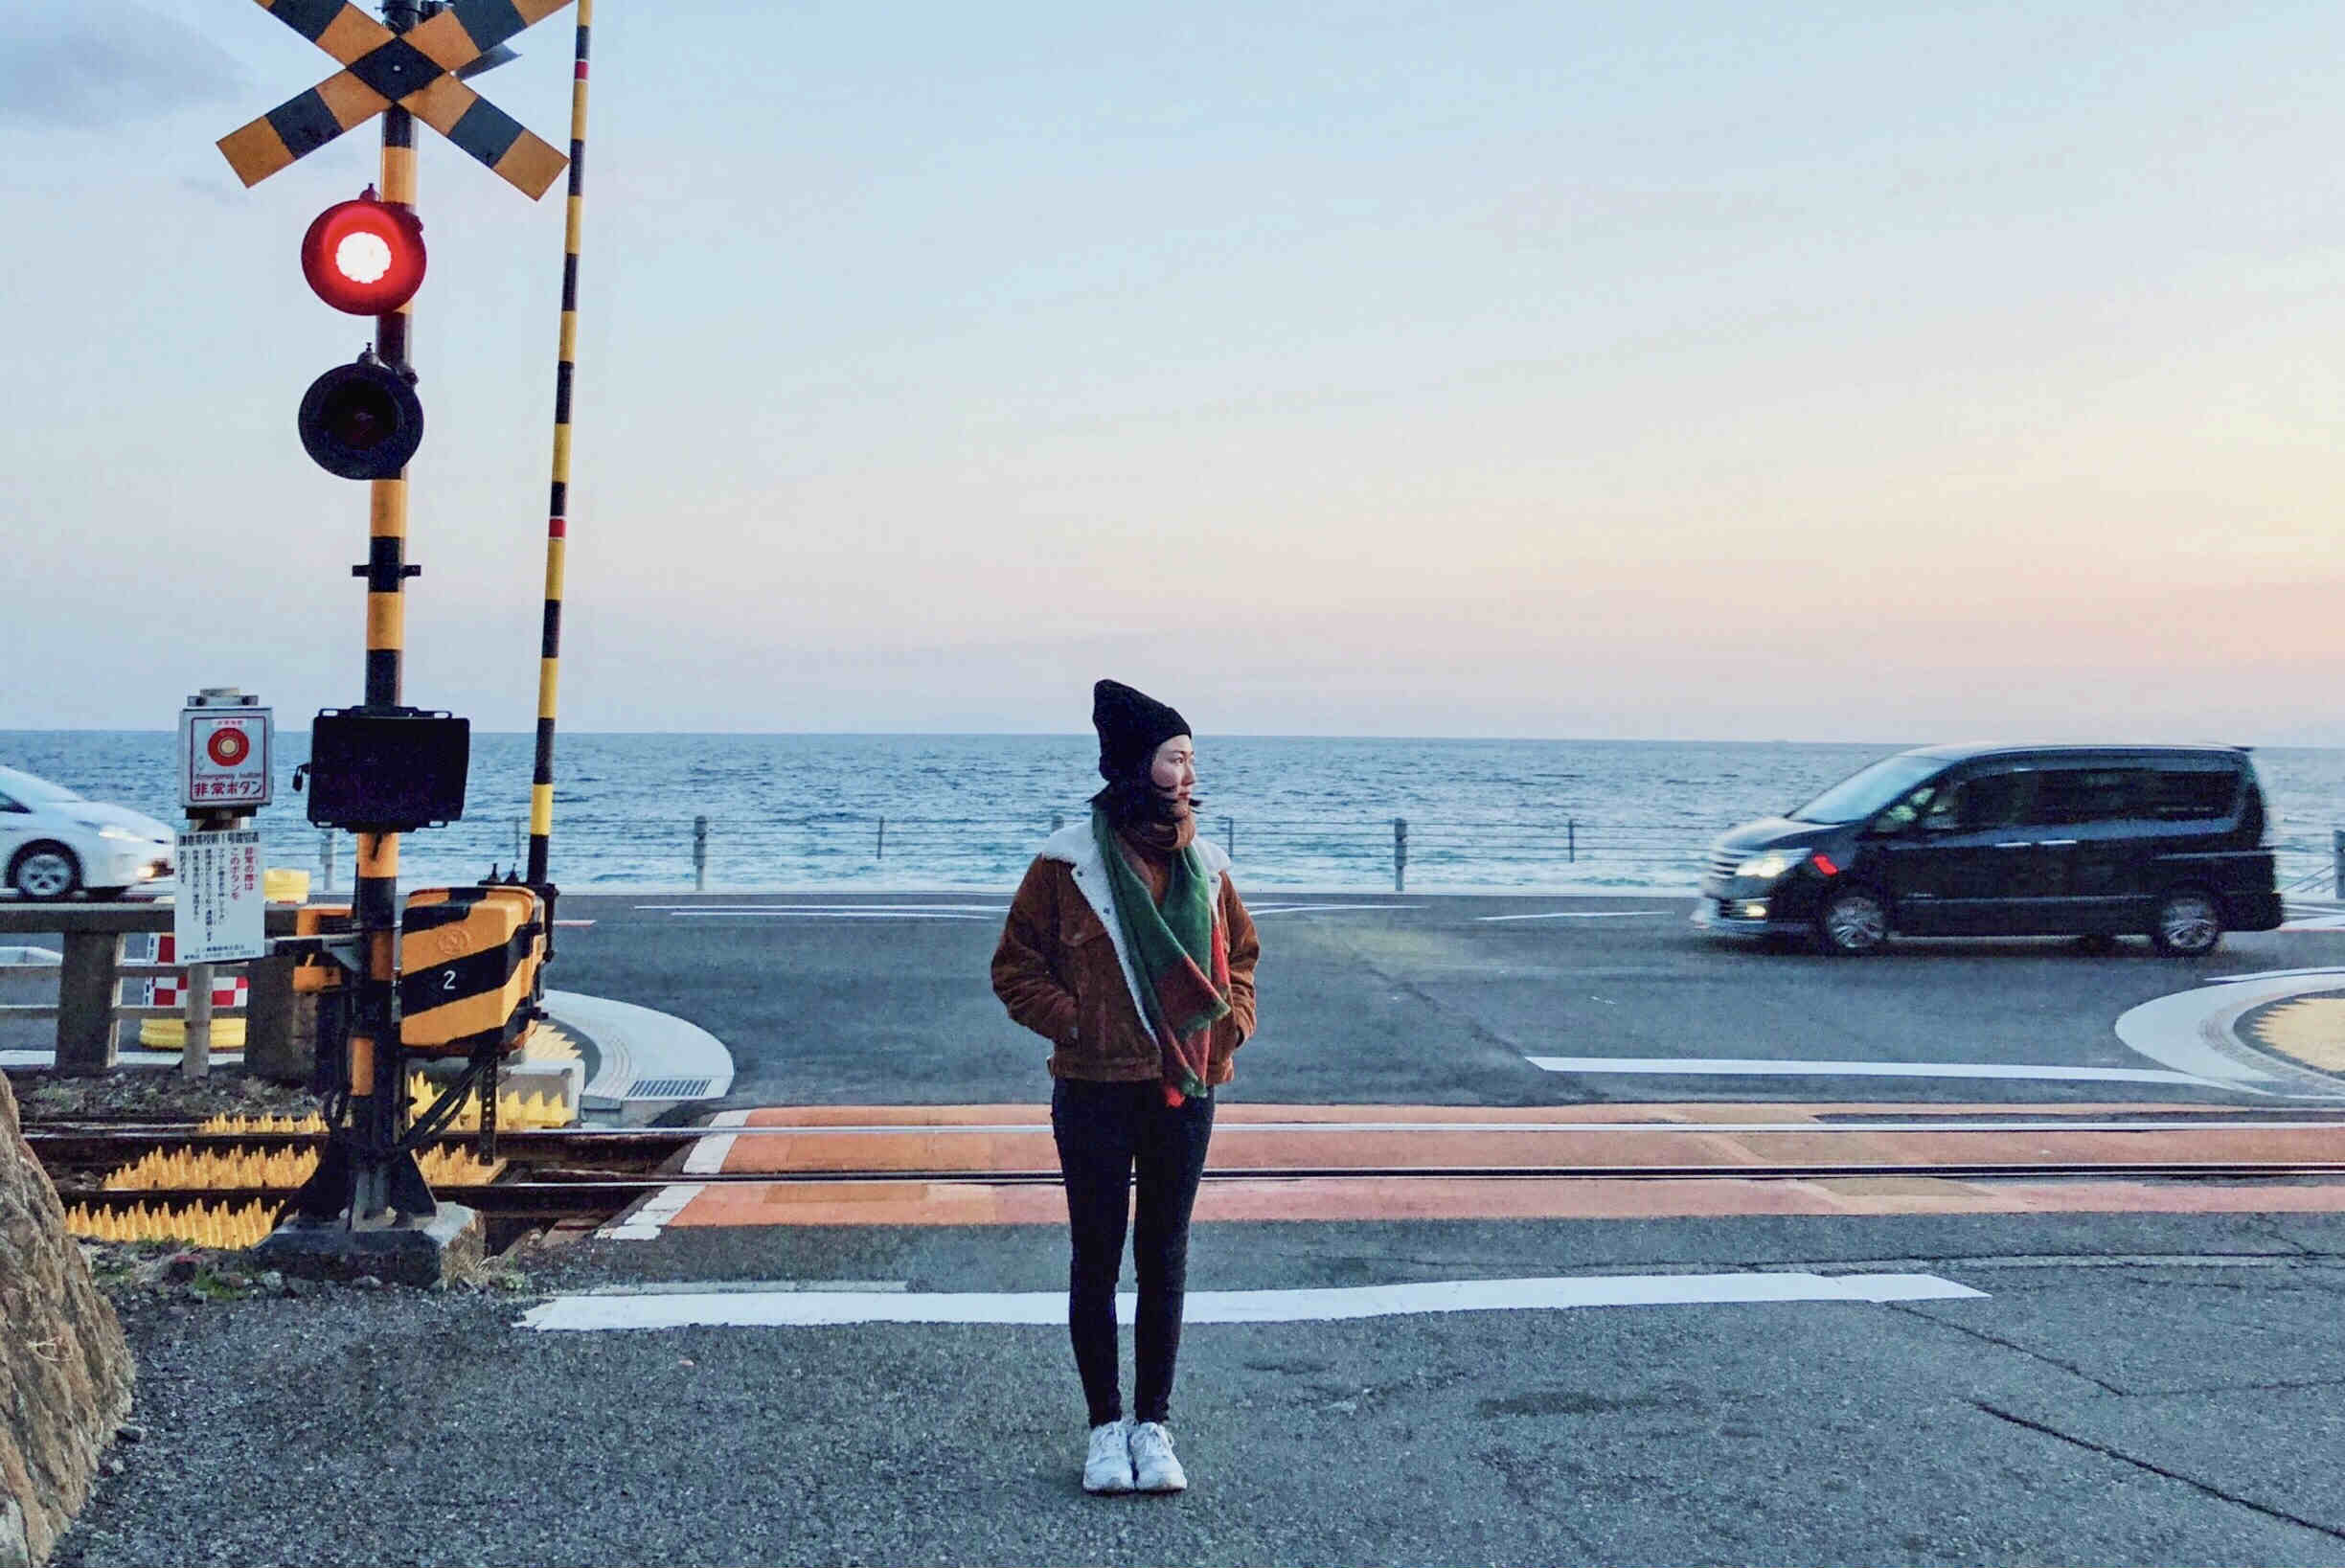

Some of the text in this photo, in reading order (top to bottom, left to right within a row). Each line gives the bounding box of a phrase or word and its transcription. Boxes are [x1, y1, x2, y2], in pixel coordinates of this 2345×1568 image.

[194, 781, 262, 797] 非常ボタン
[444, 970, 456, 989] 2
